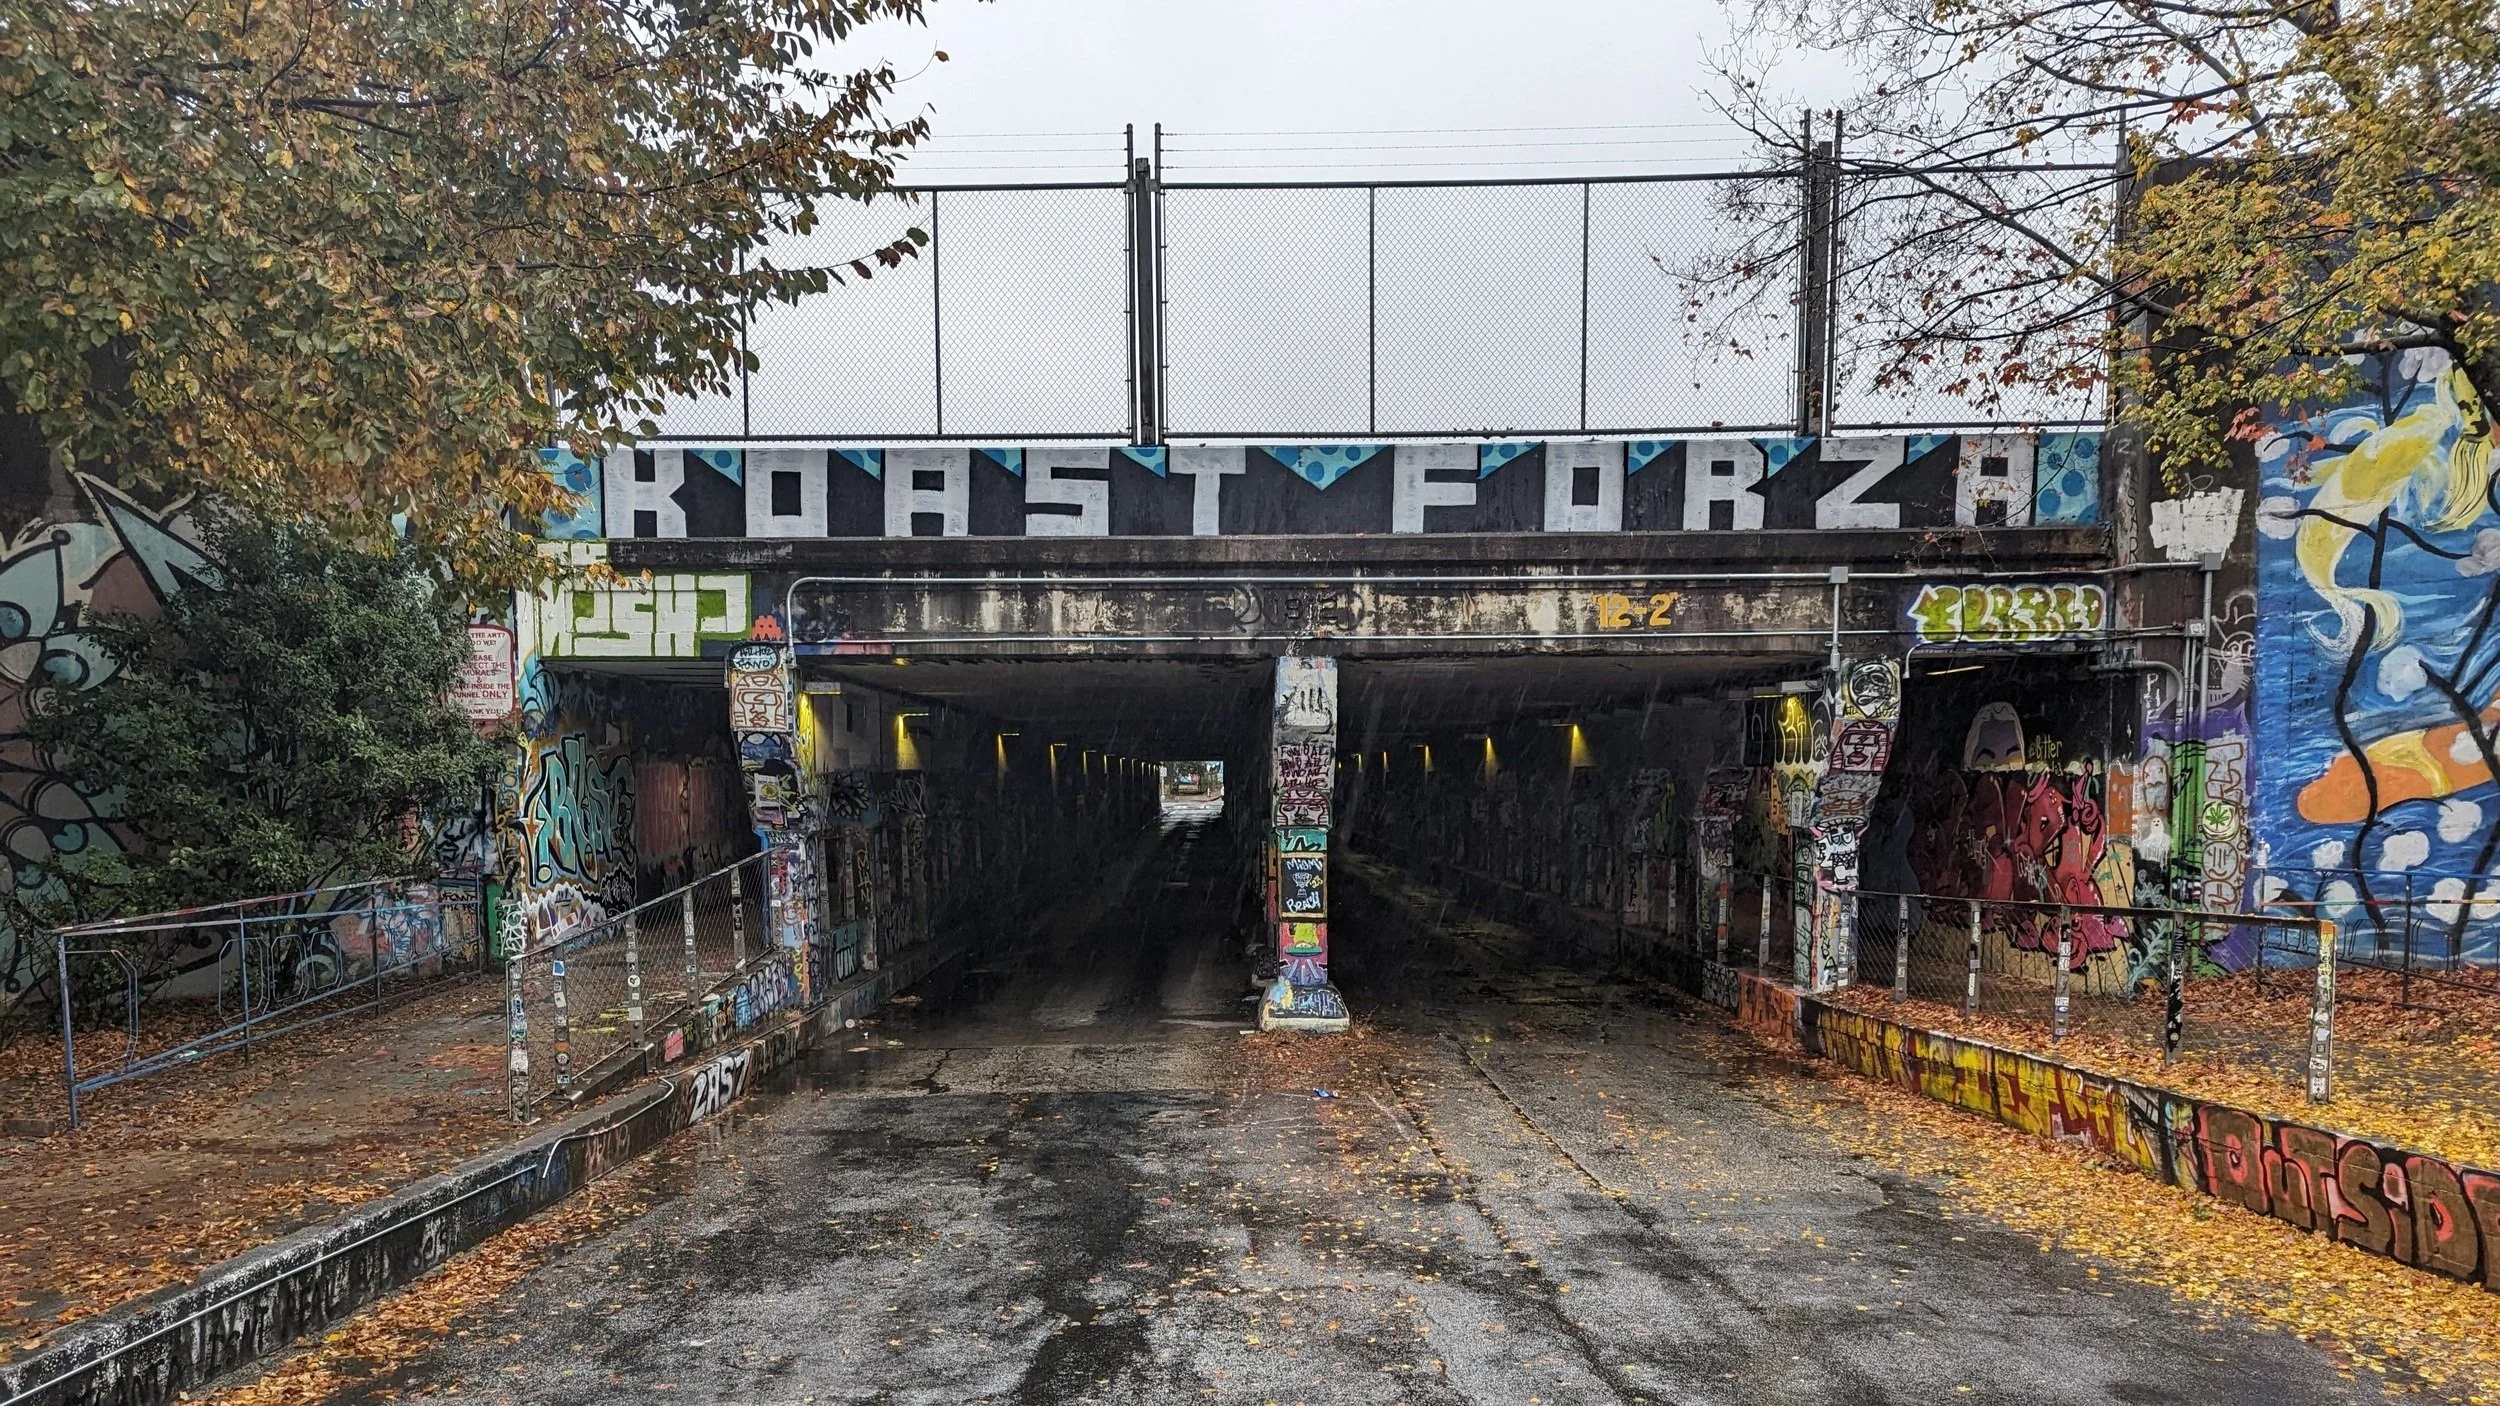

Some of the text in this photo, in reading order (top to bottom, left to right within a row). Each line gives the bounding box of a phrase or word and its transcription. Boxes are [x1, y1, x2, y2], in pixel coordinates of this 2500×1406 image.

[603, 434, 2035, 537] KOAST FORZA
[1593, 593, 1672, 628] 12-2
[490, 661, 507, 669] THE
[482, 690, 508, 698] ONLY
